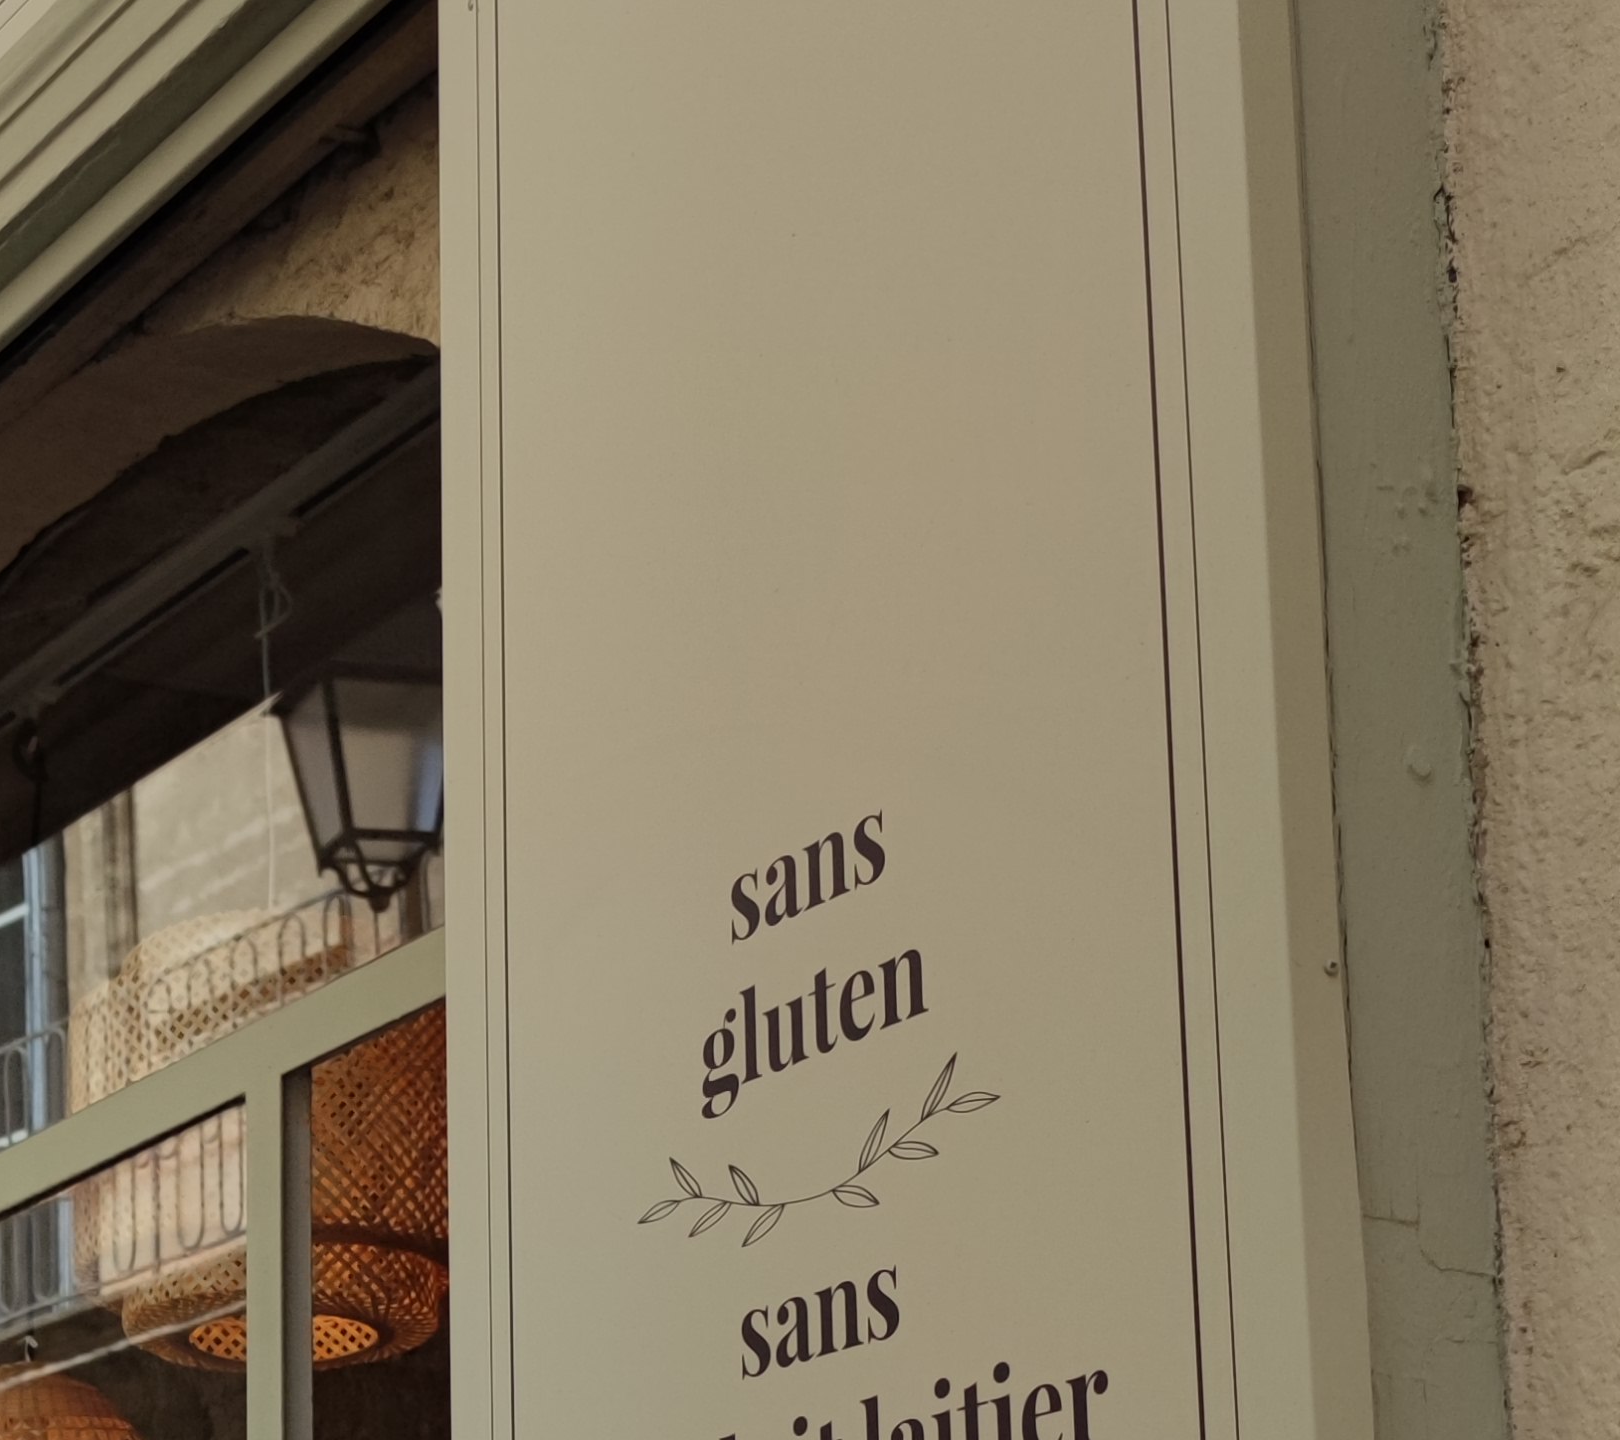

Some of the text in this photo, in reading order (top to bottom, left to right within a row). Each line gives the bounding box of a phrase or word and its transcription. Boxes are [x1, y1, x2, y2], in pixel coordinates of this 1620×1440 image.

[730, 809, 886, 946] sans
[700, 948, 930, 1120] gluten
[740, 1264, 900, 1381] sans
